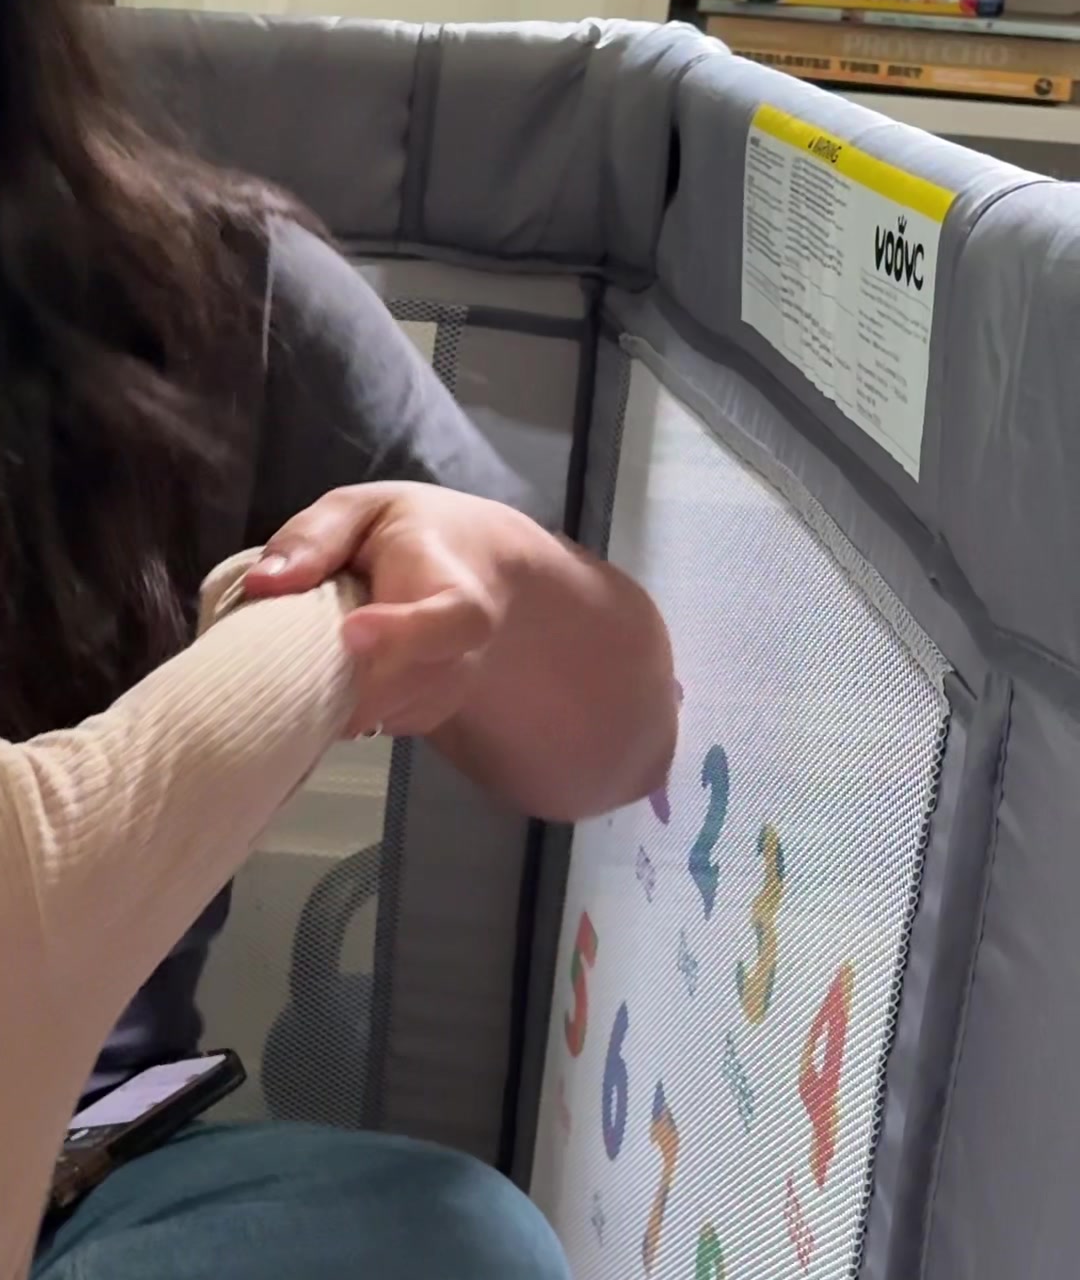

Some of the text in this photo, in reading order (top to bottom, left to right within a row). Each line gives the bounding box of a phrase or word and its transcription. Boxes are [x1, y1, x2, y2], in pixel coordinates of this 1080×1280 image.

[564, 909, 599, 1059] 5
[602, 999, 629, 1161] 6
[688, 744, 729, 921] 2
[736, 821, 785, 1025] 3
[798, 958, 855, 1188] 4
